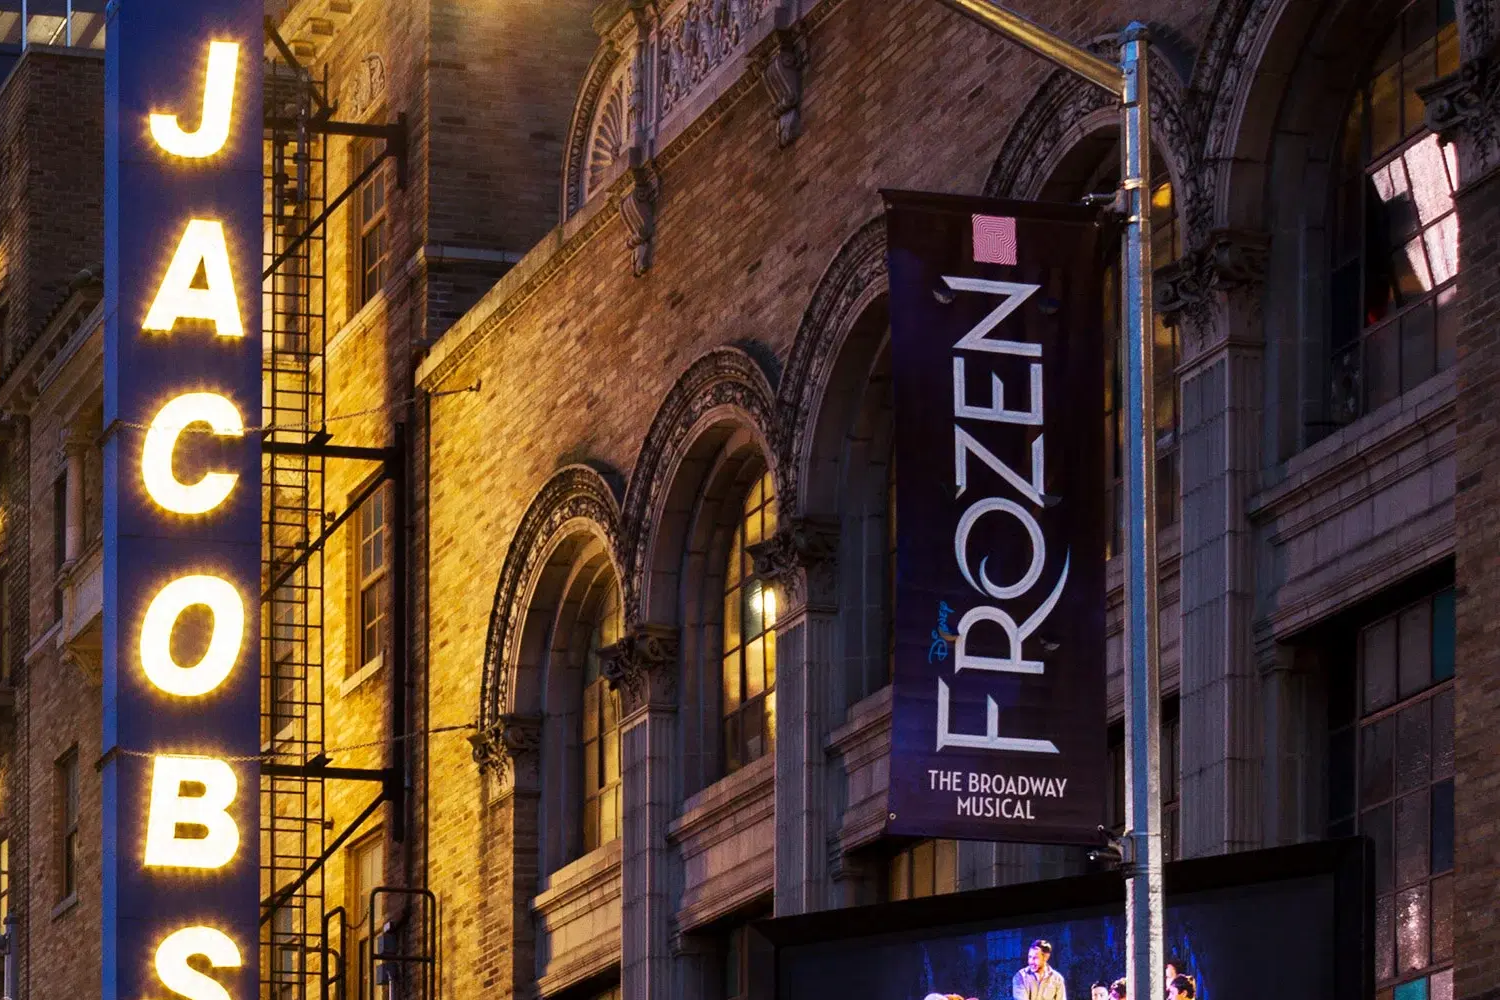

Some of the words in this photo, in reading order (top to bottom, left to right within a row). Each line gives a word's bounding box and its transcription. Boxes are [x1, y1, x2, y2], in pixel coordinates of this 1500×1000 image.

[935, 275, 1071, 755] FROZEN
[928, 770, 962, 792] THE
[968, 772, 1068, 798] BROADWAY
[956, 796, 1036, 820] MUSICAL
